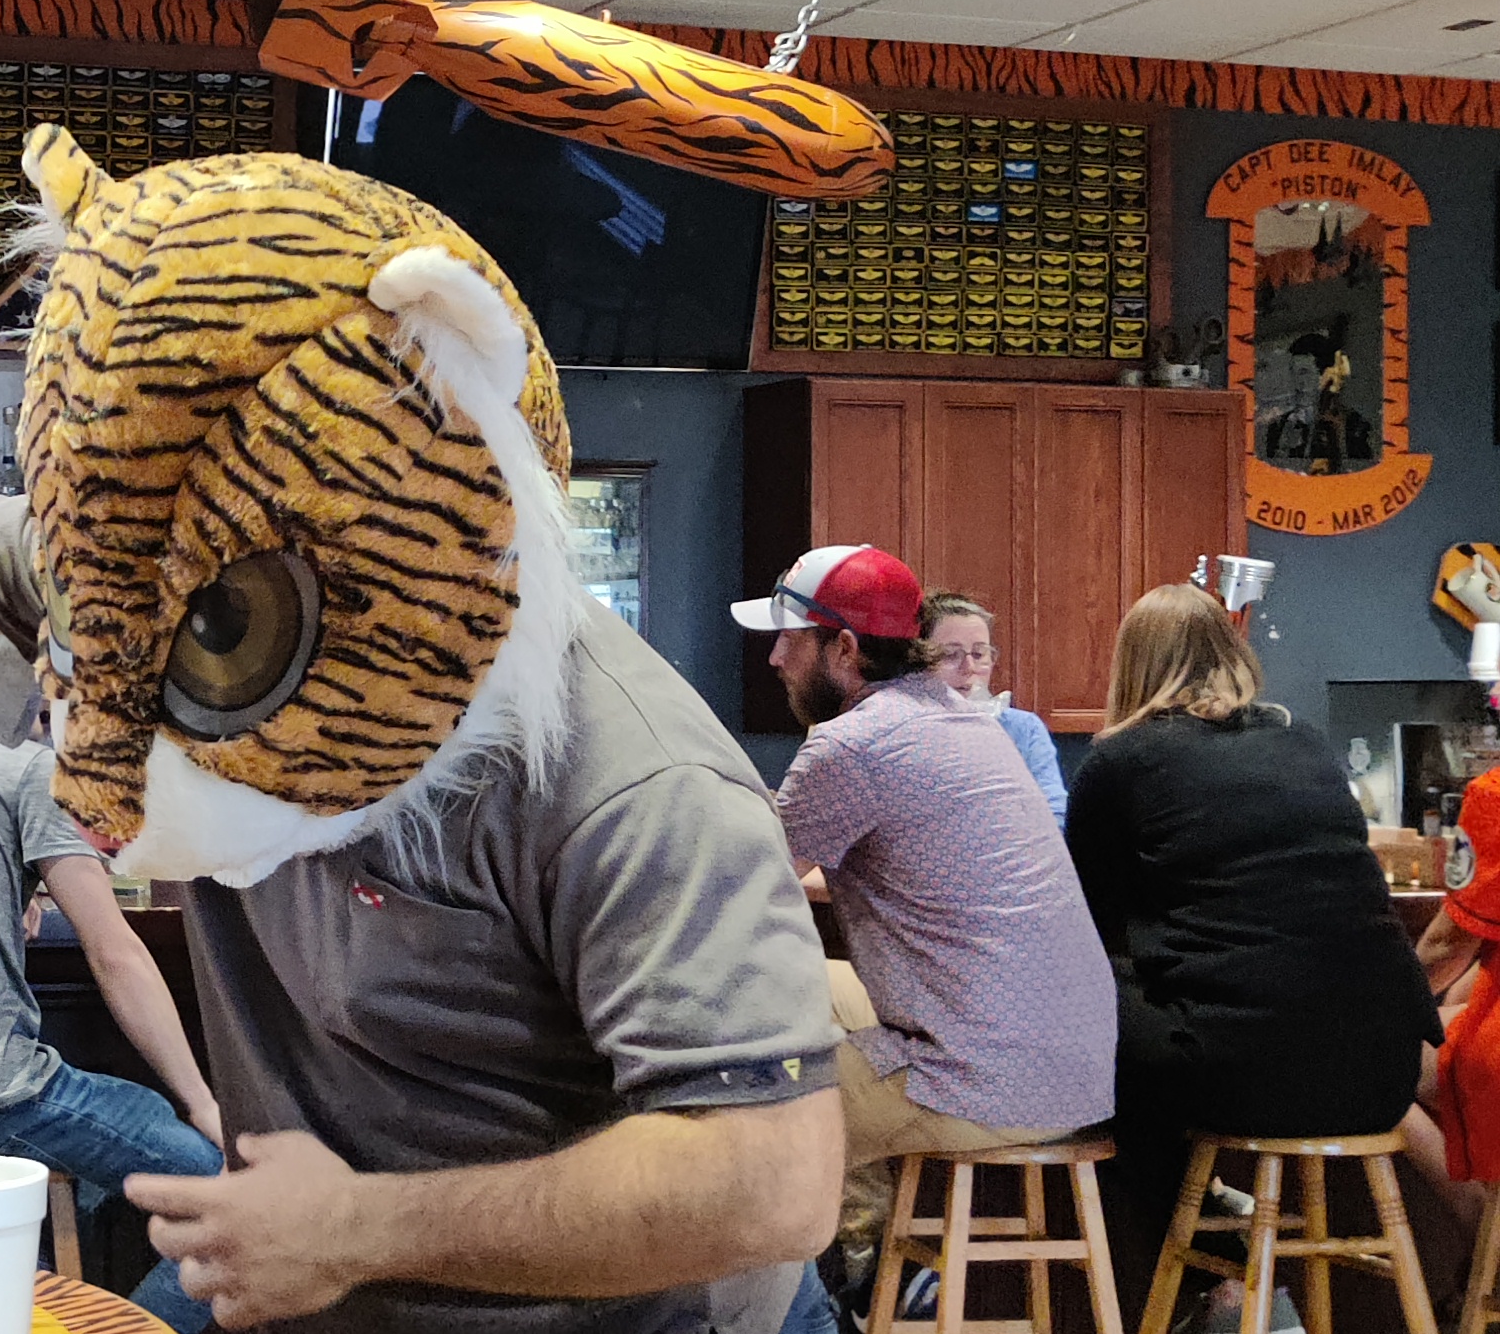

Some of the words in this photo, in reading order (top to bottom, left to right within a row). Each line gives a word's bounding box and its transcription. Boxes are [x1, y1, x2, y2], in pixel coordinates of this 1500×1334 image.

[1222, 151, 1274, 193] CAPT
[1288, 142, 1331, 164] DEE
[1349, 148, 1417, 199] IMLAY
[1257, 501, 1306, 531] 2010
[1332, 506, 1375, 532] MAR
[1380, 469, 1424, 516] 2012
